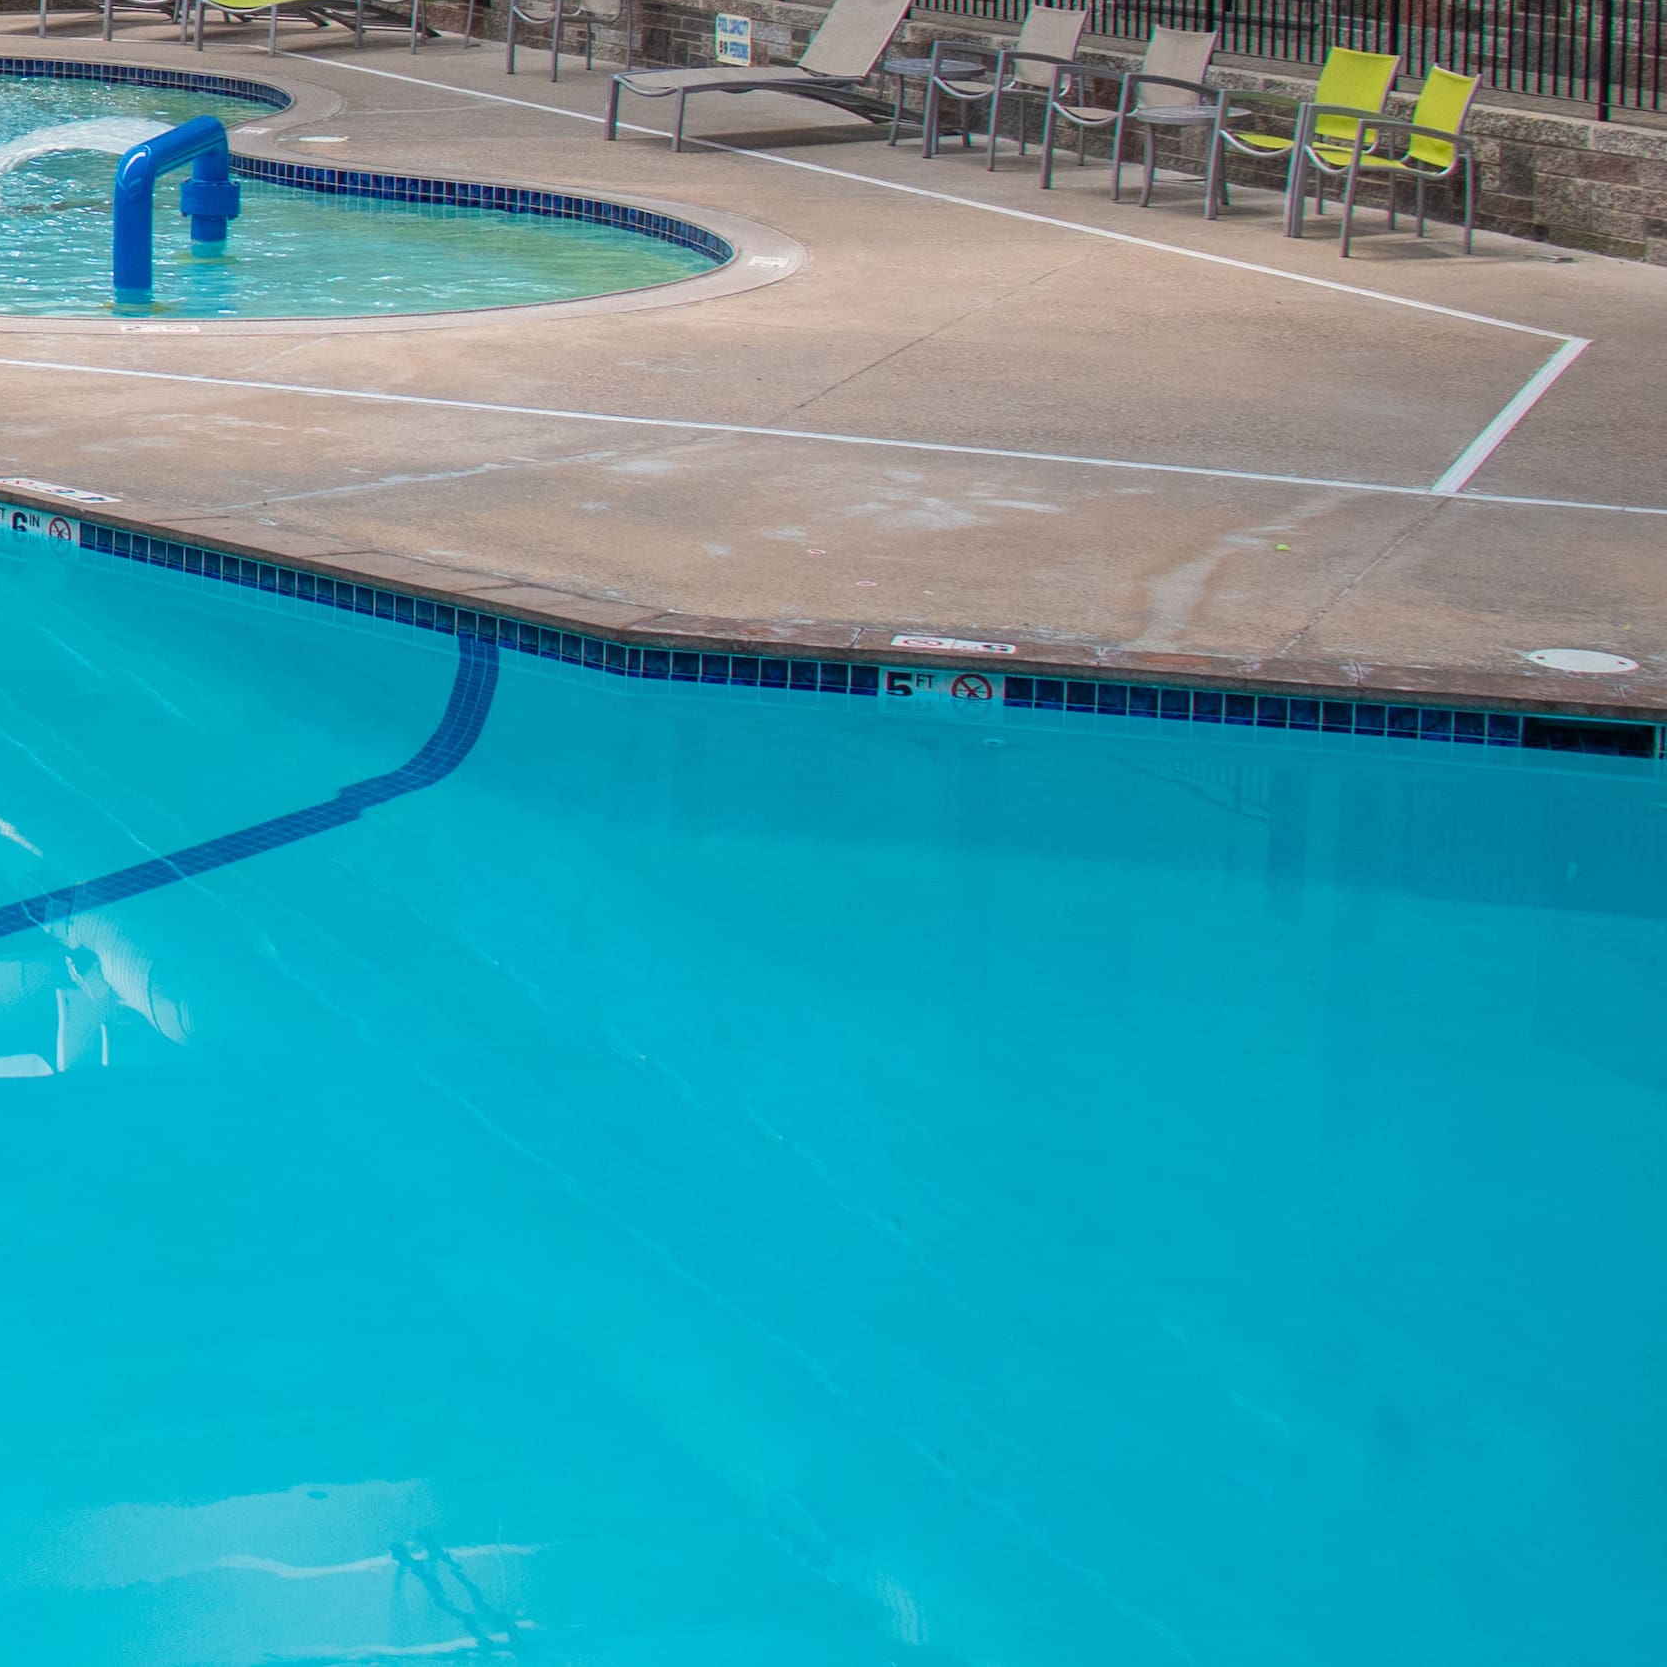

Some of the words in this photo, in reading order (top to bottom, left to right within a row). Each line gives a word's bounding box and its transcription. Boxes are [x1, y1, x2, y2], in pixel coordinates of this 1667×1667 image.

[12, 512, 27, 532] 6
[29, 515, 40, 528] IN
[886, 671, 912, 696] 5
[916, 674, 935, 688] FT
